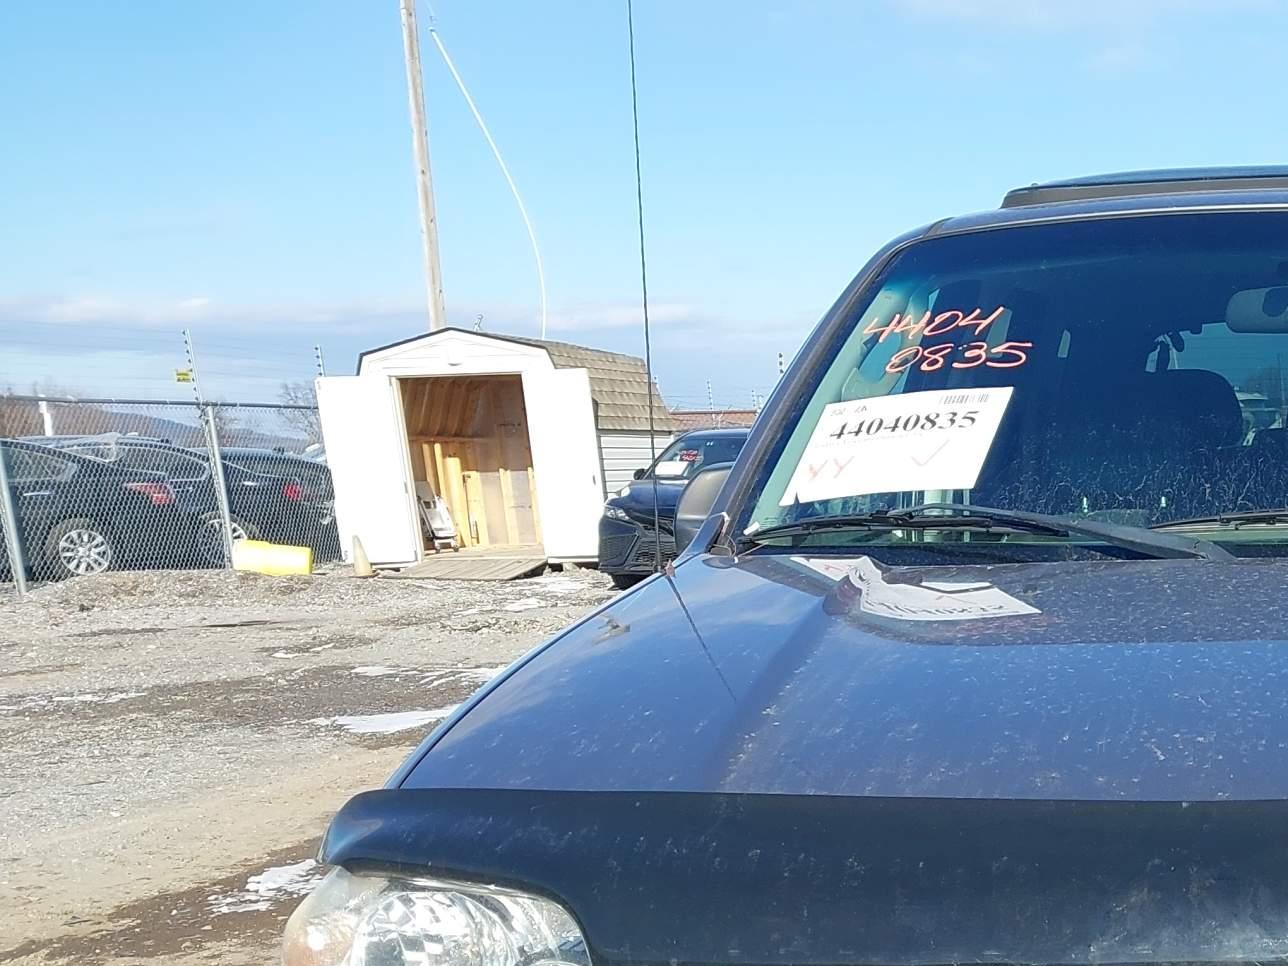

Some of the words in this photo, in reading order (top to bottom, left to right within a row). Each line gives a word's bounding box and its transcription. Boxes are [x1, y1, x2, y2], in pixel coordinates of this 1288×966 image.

[863, 306, 1004, 343] 4404
[885, 341, 1033, 373] 0835
[829, 410, 980, 440] 44040835
